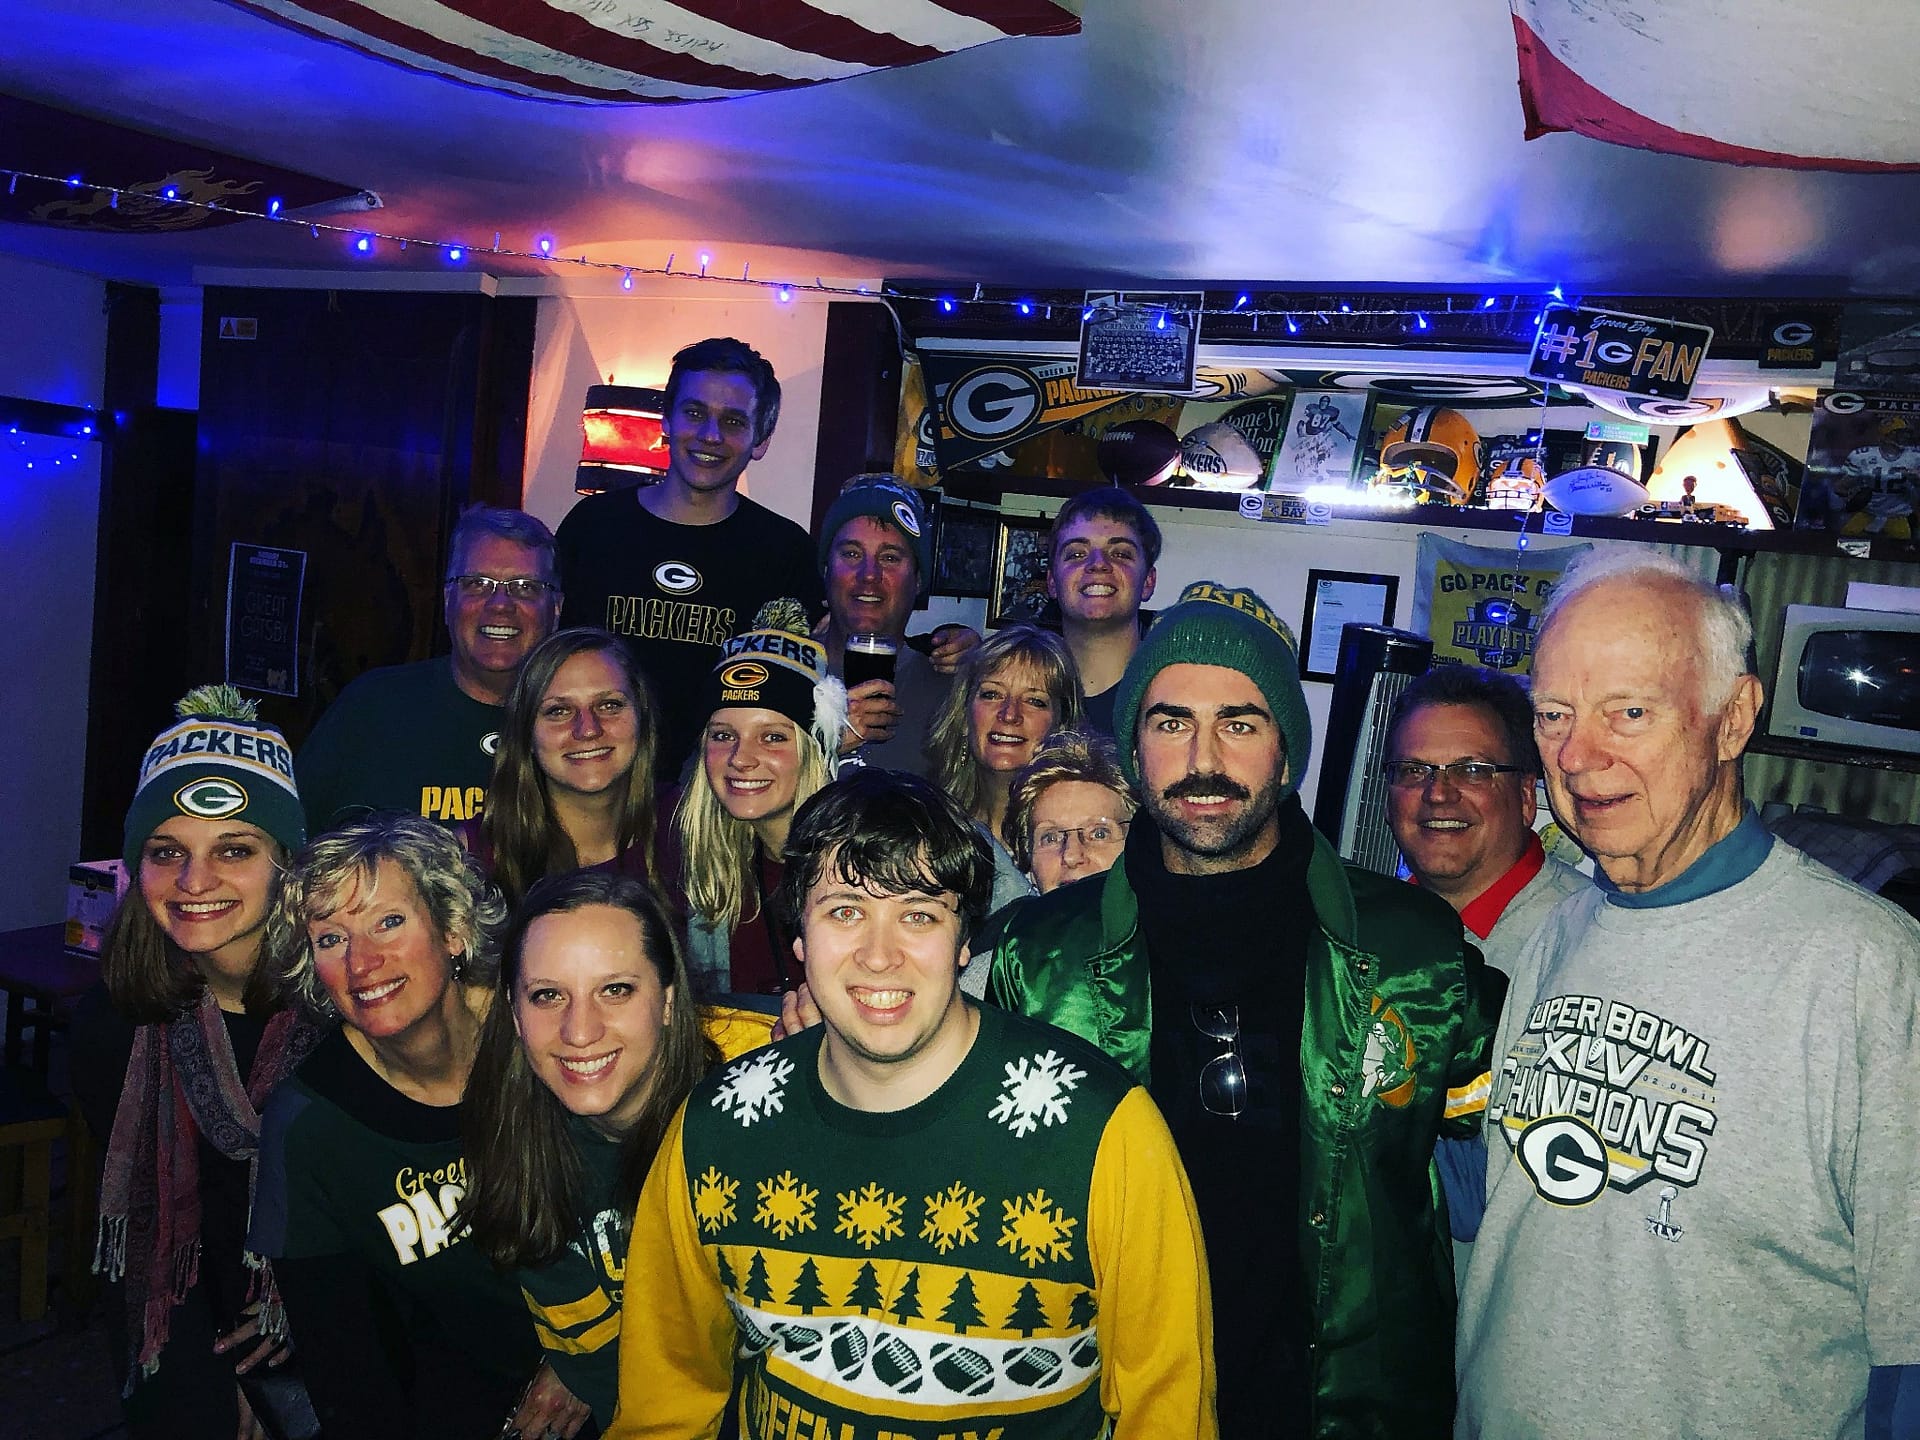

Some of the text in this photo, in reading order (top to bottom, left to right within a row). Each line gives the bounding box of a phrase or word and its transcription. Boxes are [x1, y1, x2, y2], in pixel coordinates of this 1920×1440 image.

[1589, 314, 1657, 336] Green Bay
[1540, 323, 1599, 369] #1
[1631, 337, 1702, 385] FAN
[1767, 347, 1815, 362] PACKERS
[1582, 369, 1631, 390] PACKERS
[1312, 413, 1331, 428] 87
[1281, 506, 1305, 518] BAY
[1440, 574, 1467, 593] GO
[1472, 573, 1530, 594] PACK
[606, 595, 736, 647] PACKERS
[1456, 624, 1534, 650] PLAYOFF
[721, 689, 760, 702] PACKERS
[144, 730, 293, 778] PACKERS
[421, 786, 484, 820] PAC
[1529, 994, 1718, 1088] UPER BOWL
[1535, 1031, 1654, 1092] XLV
[1489, 1056, 1719, 1188] CHAMPIONS
[376, 1184, 473, 1266] PAC
